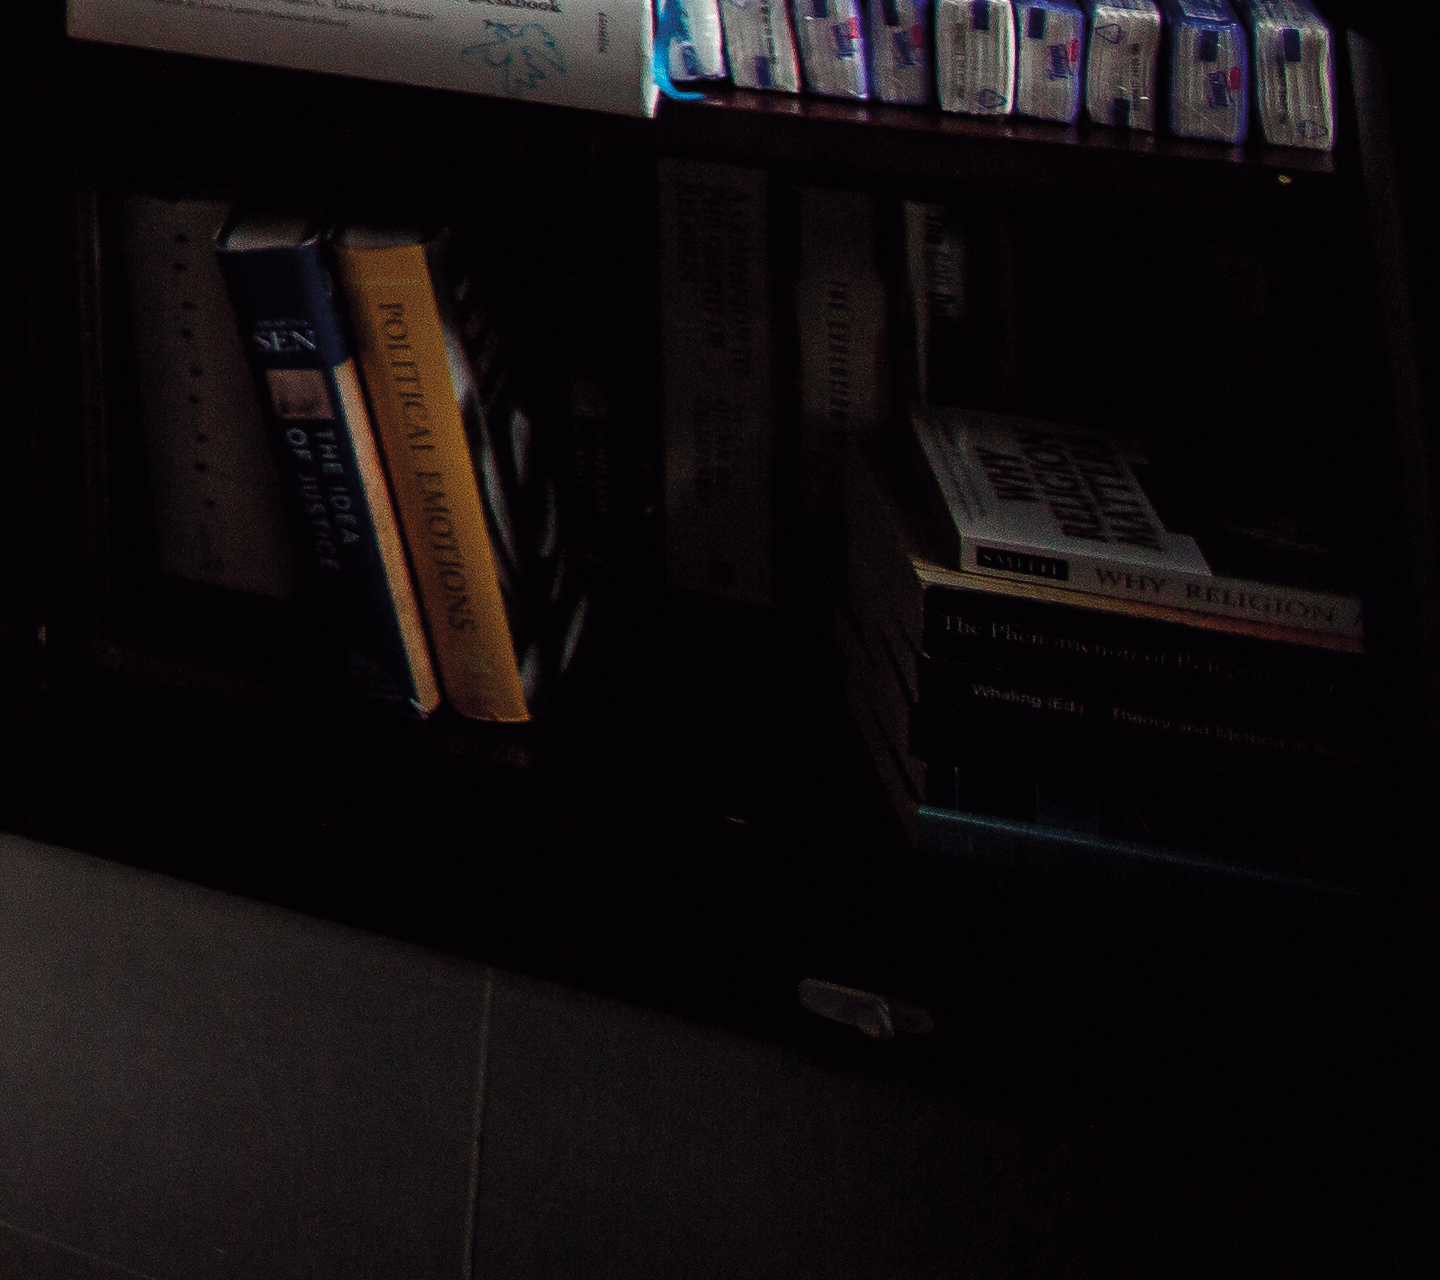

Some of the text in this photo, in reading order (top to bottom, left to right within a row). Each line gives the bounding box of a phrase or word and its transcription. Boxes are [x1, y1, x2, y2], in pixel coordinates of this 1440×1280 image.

[285, 428, 341, 571] OF JUSTICE
[313, 429, 361, 545] THE IDEA
[416, 472, 477, 632] EMOTIONS
[1095, 568, 1335, 623] WHY RELIGION
